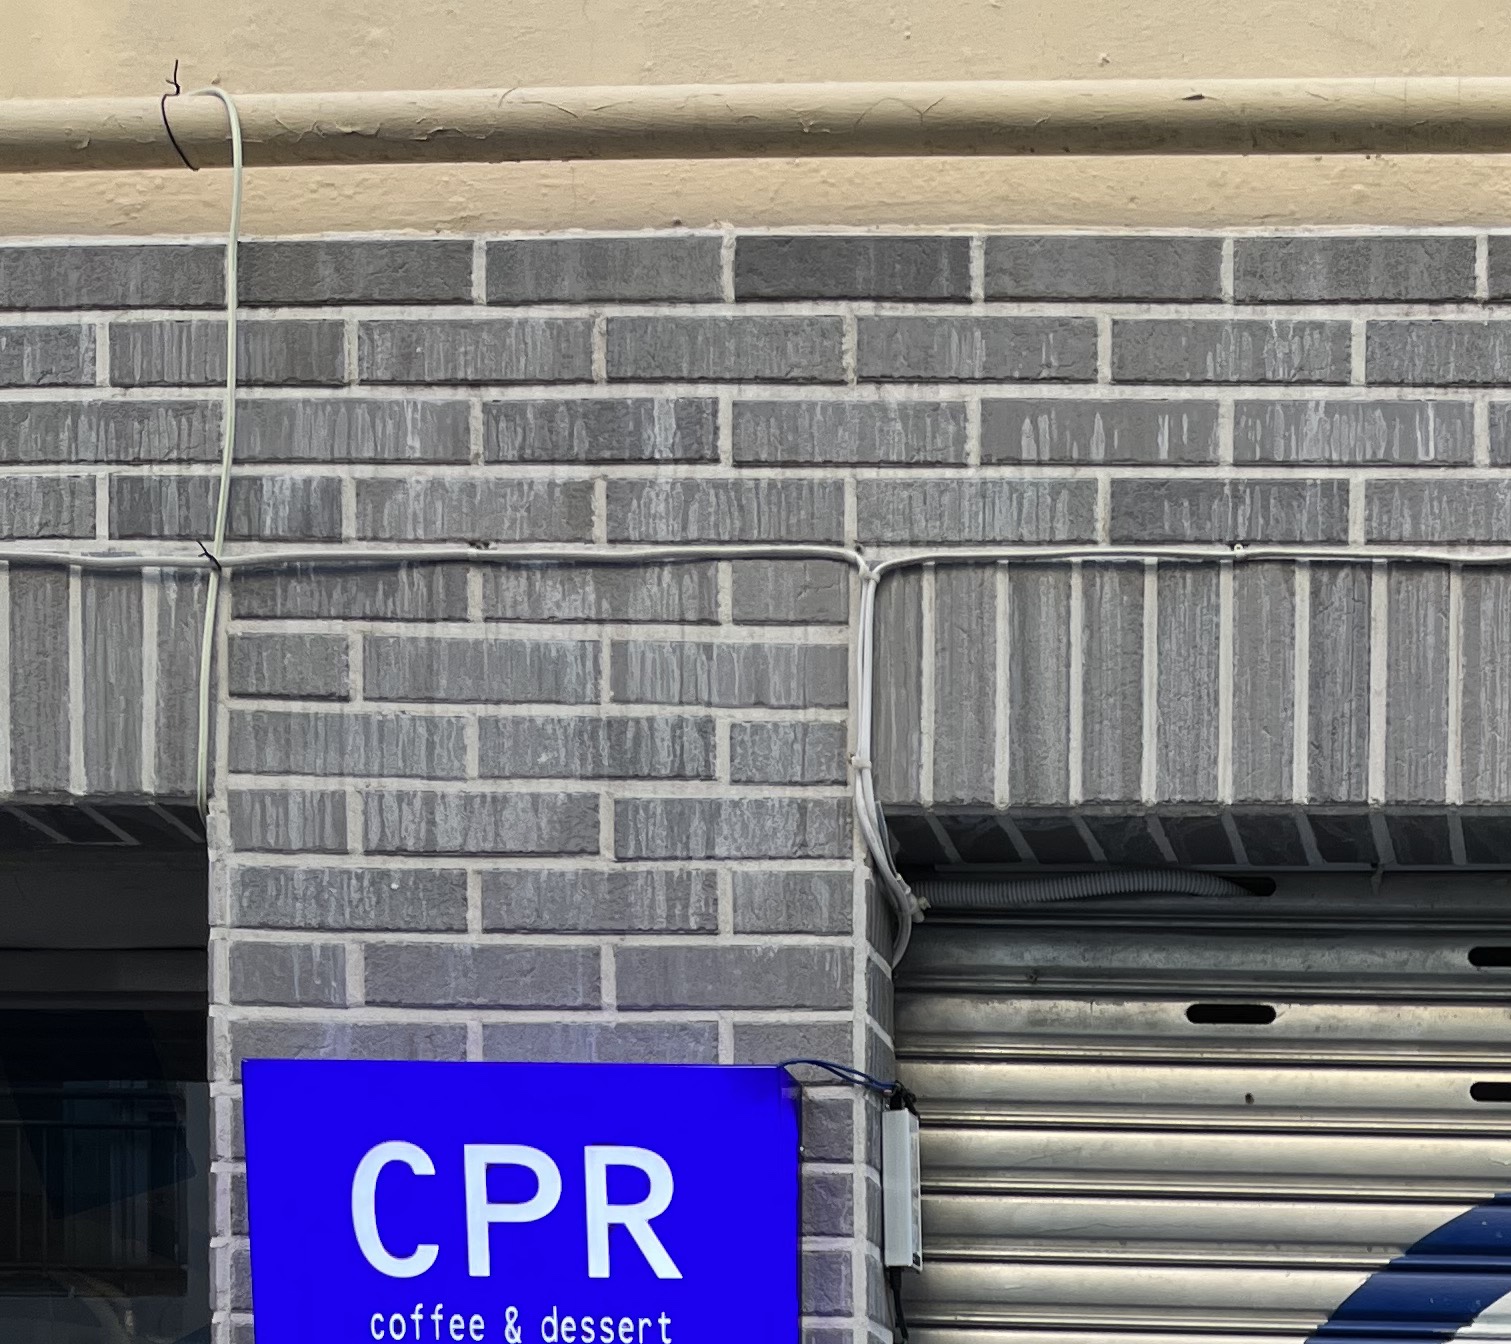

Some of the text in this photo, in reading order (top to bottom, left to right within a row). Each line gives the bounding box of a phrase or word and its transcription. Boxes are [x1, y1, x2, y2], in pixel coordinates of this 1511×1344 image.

[351, 1140, 684, 1280] CPR
[370, 1302, 672, 1344] coffee & dessert
